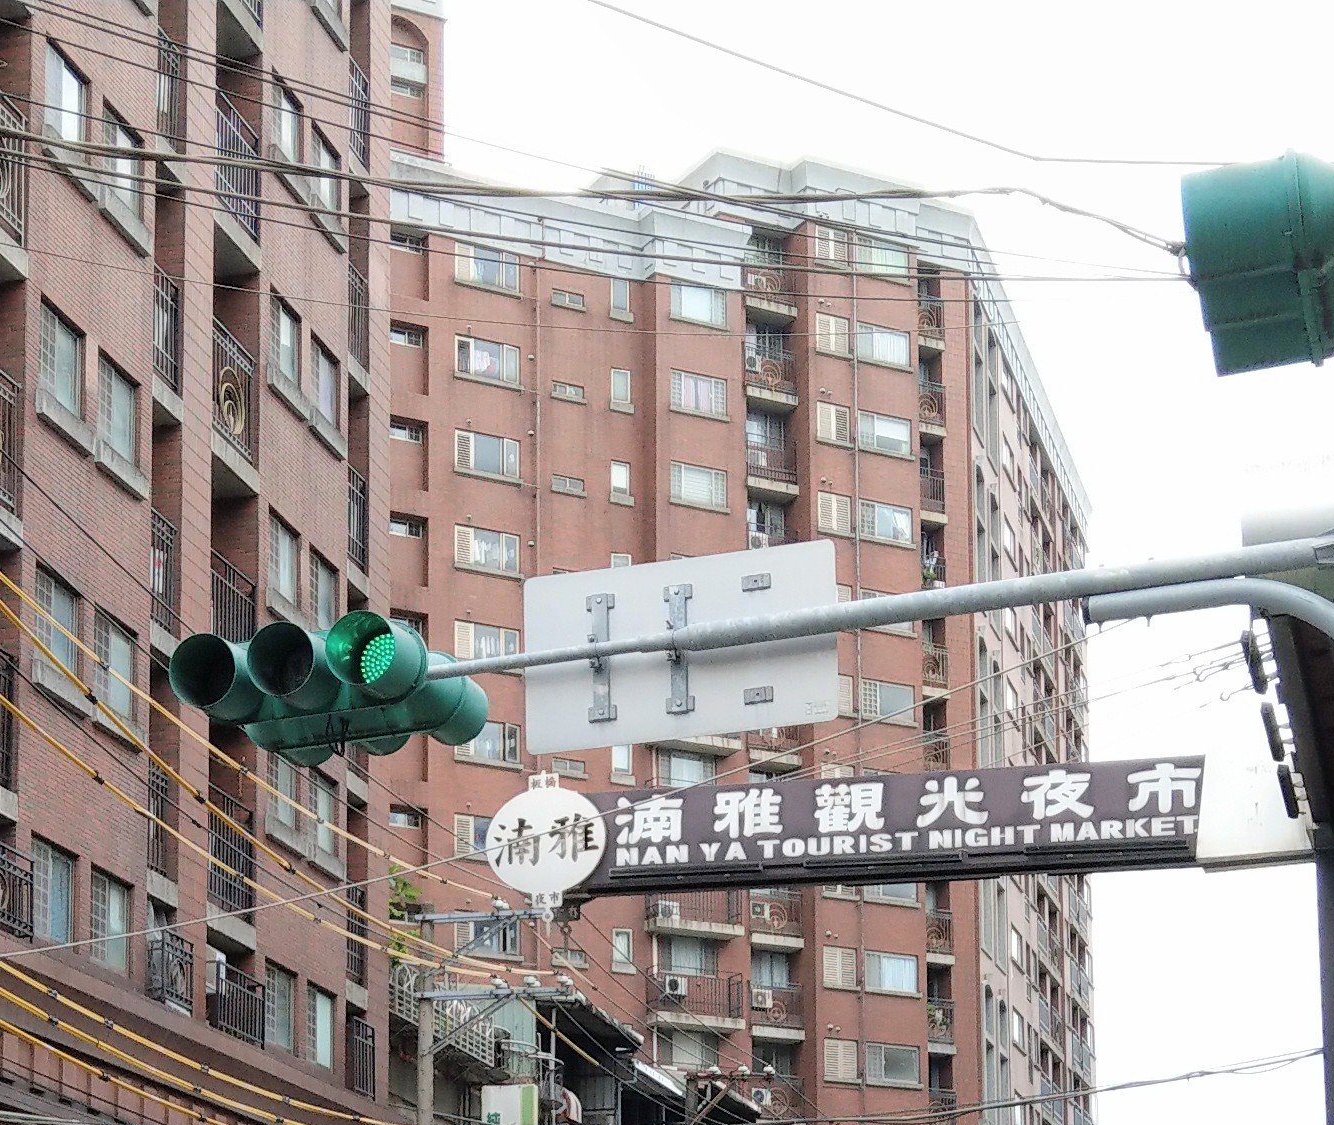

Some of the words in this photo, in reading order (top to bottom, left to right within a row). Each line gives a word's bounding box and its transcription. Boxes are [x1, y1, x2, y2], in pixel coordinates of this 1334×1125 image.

[616, 764, 1200, 843] 湳雅觀光夜市
[494, 813, 599, 868] 湳雅
[616, 842, 690, 867] NAN
[703, 841, 746, 863] YA
[757, 829, 919, 858] TOURIST
[929, 826, 1040, 850] NIGHT
[1049, 814, 1200, 843] MARKET
